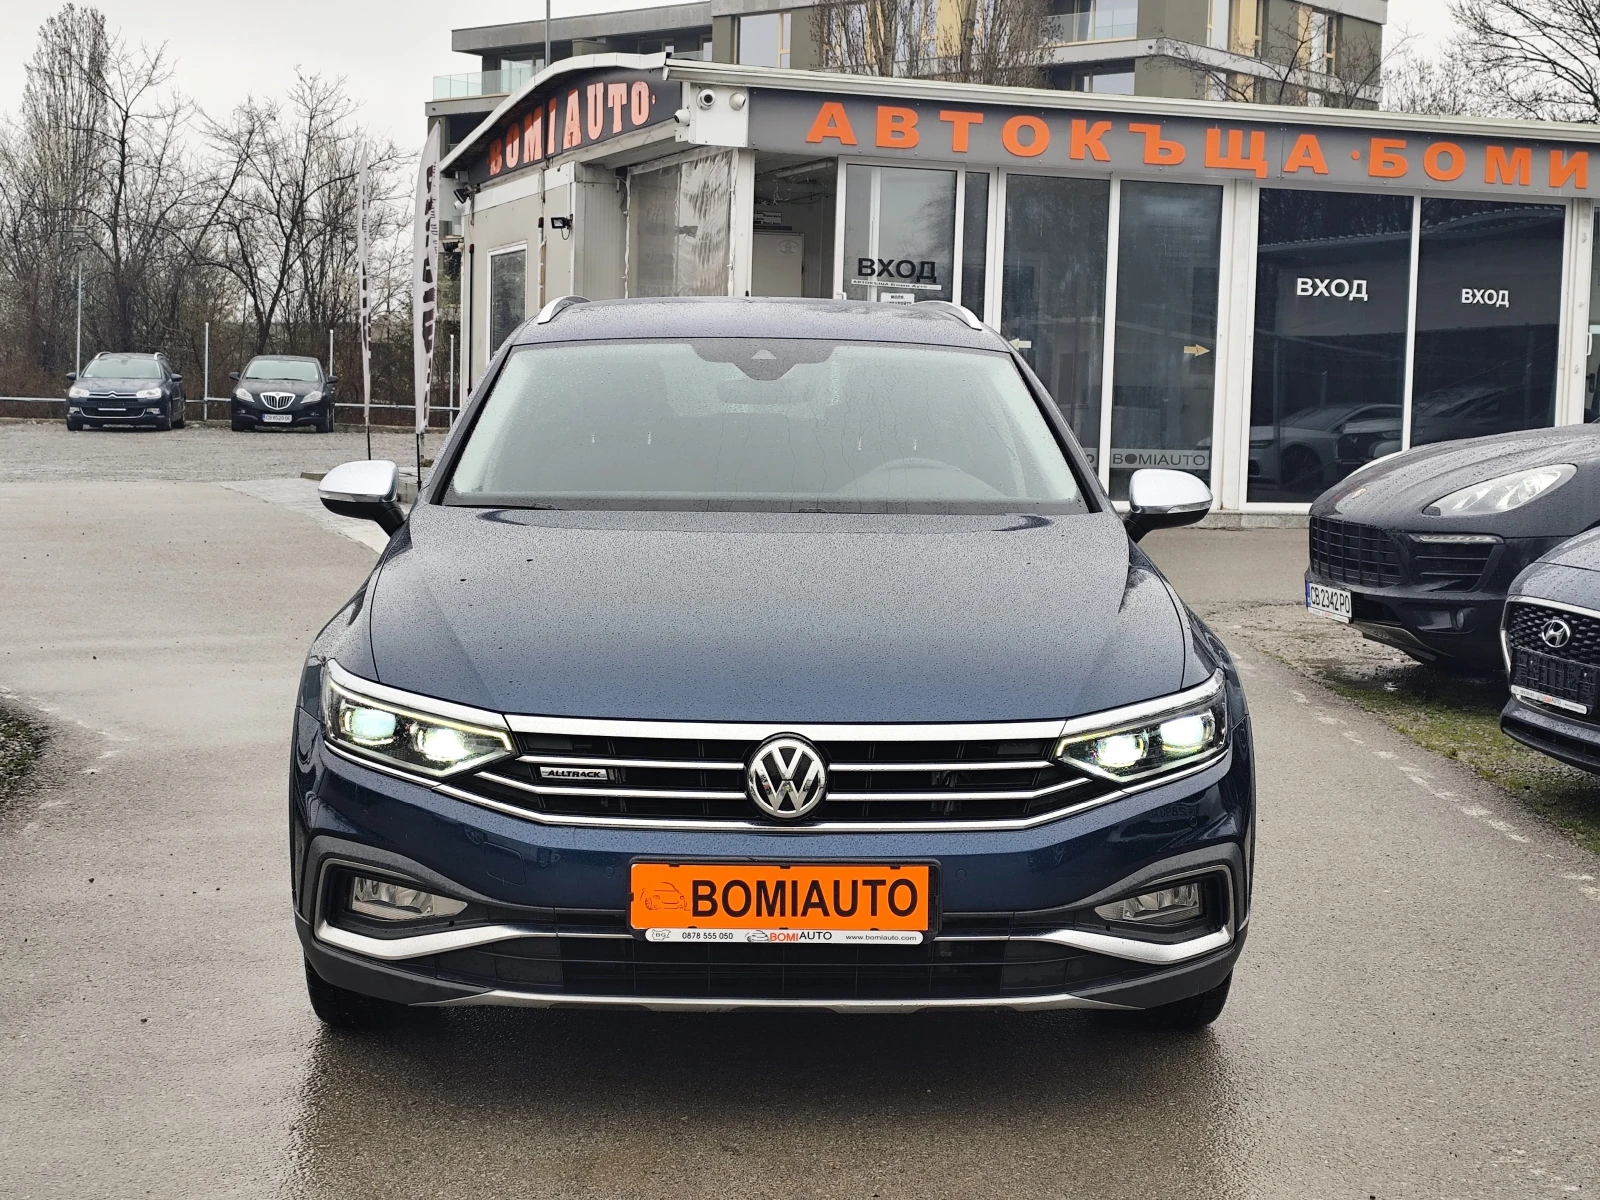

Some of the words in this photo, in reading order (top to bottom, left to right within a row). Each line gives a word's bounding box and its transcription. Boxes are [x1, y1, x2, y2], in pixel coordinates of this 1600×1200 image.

[489, 80, 650, 176] BOMIAUTO
[805, 102, 1329, 179] АВТОКЪЩА
[1368, 137, 1589, 189] БОМИ
[857, 257, 937, 284] ВХОД
[1296, 277, 1368, 302] ВХОД
[1461, 288, 1510, 308] ВХОД
[1112, 453, 1206, 466] BOMIAUTO
[547, 769, 601, 778] ALLTRACK
[691, 878, 919, 918] BOMIAUTO
[681, 931, 701, 940] 0878
[703, 932, 717, 940] 555
[719, 932, 734, 940] 050
